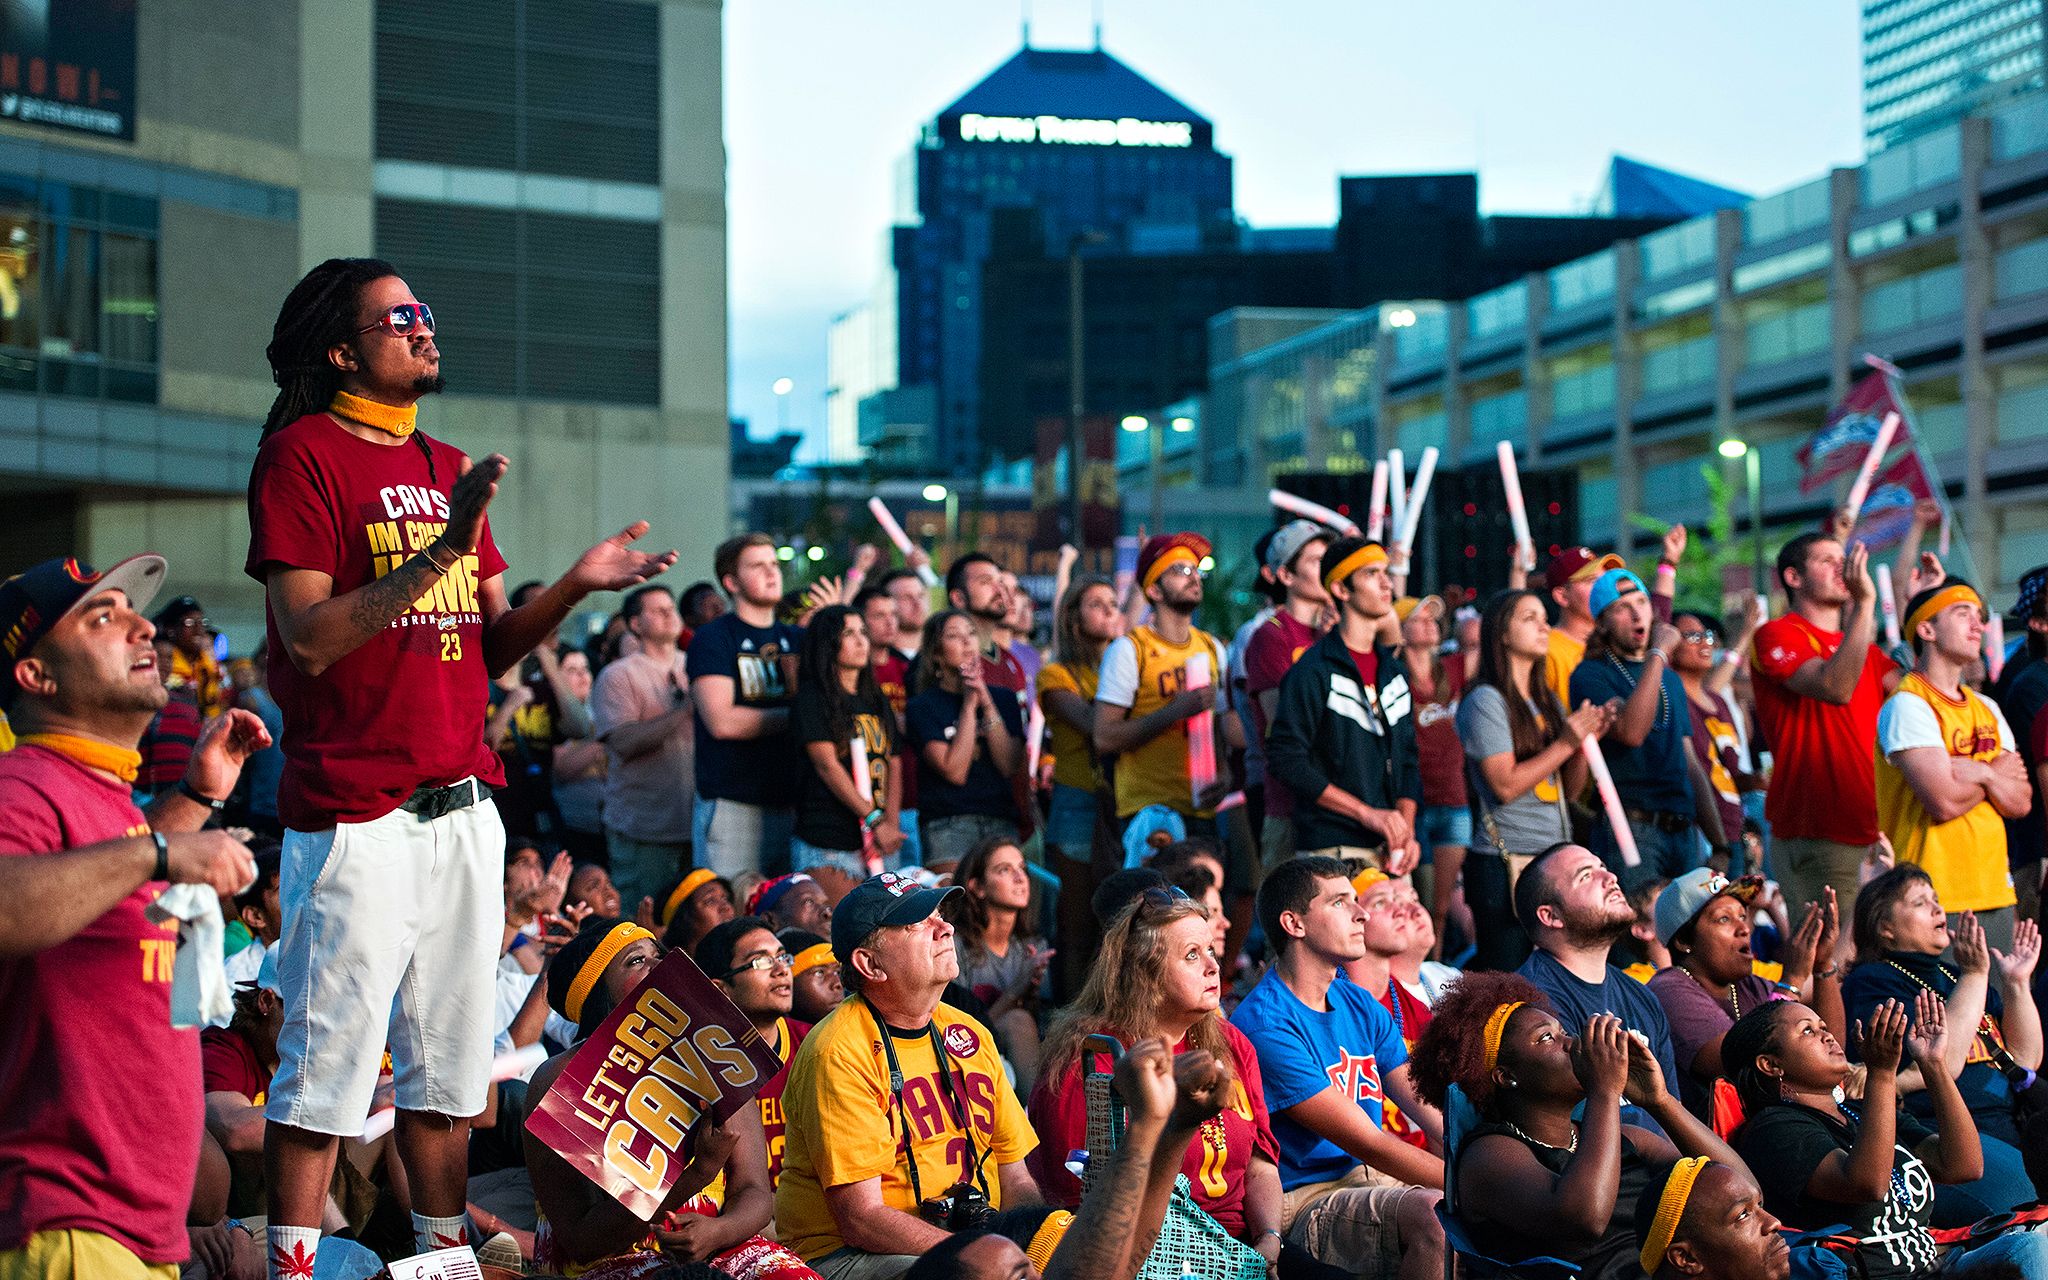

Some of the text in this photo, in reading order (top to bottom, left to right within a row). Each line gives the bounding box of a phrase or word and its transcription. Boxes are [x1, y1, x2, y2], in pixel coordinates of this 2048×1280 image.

[380, 484, 450, 520] CAVS
[366, 521, 403, 554] IM
[385, 614, 436, 628] EBRON
[440, 632, 462, 661] 23
[574, 987, 691, 1131] LET'S GO
[603, 1024, 758, 1195] CAVS
